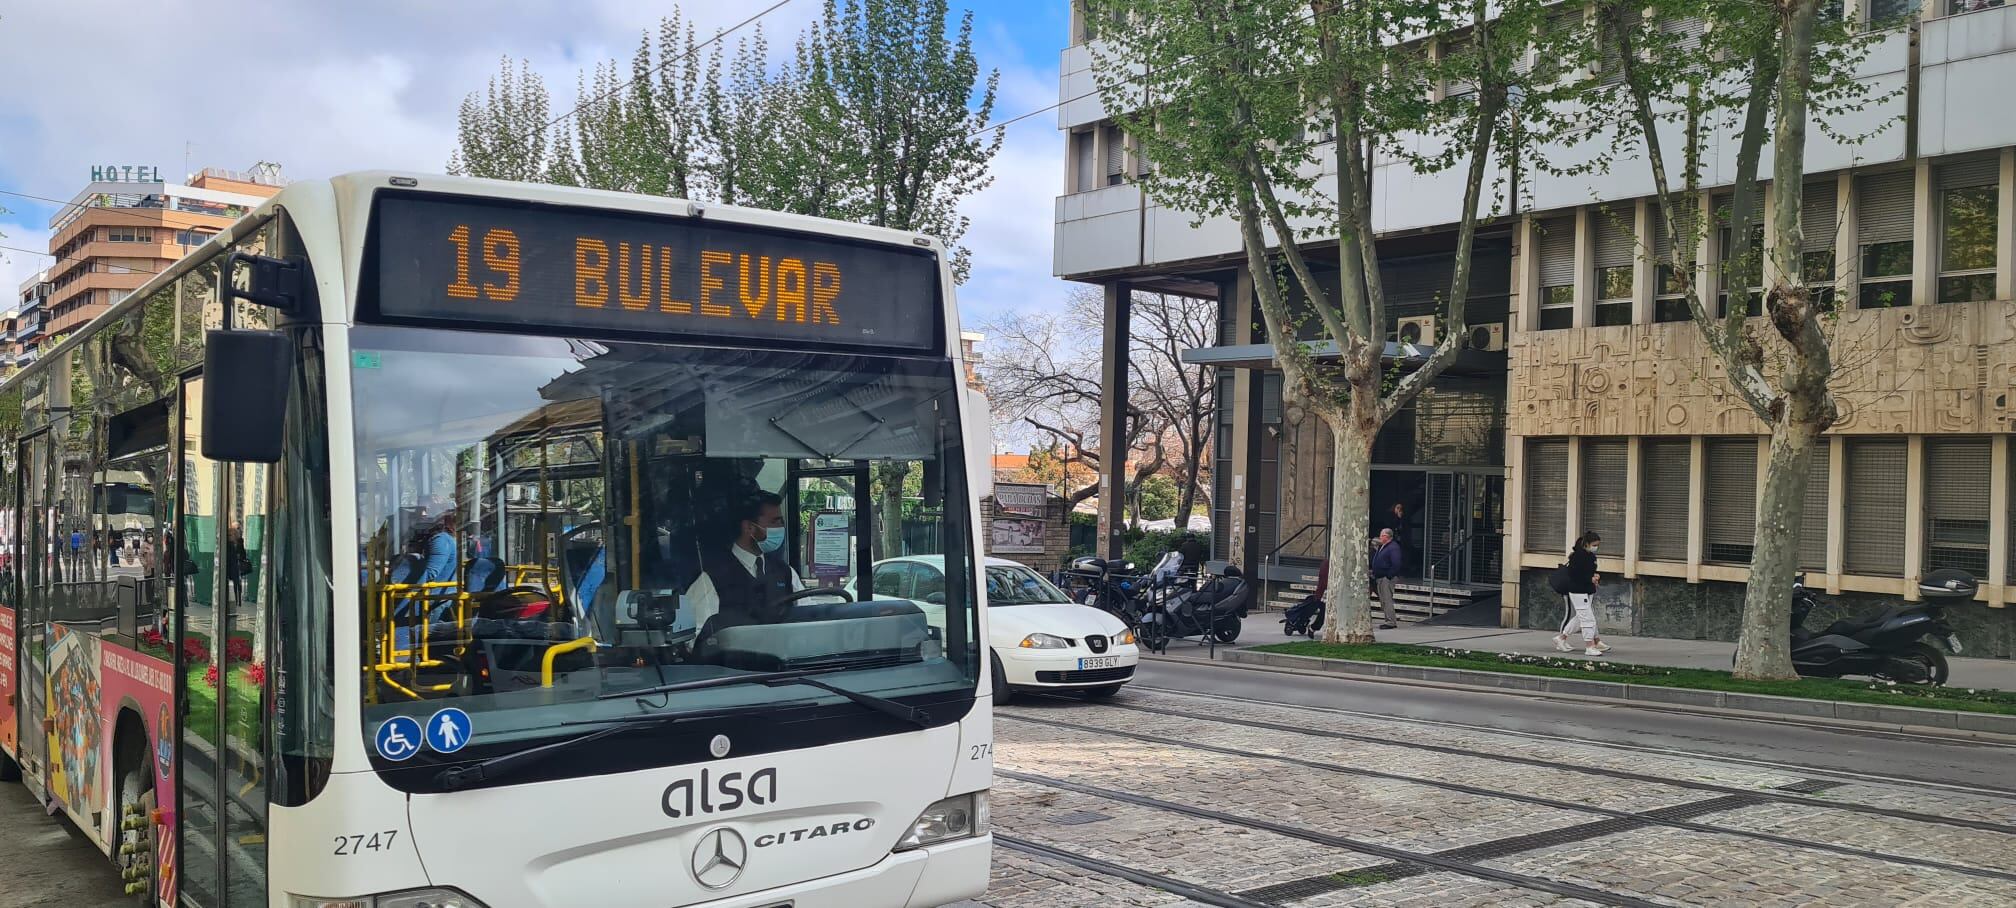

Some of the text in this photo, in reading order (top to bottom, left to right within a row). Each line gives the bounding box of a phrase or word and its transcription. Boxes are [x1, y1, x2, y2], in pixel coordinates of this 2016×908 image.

[91, 165, 164, 183] HOTEL
[447, 224, 842, 325] 19 BULEVAR
[1083, 658, 1104, 670] 8939
[660, 766, 778, 819] alsa
[334, 829, 398, 856] 2747
[754, 818, 873, 848] CITARO
